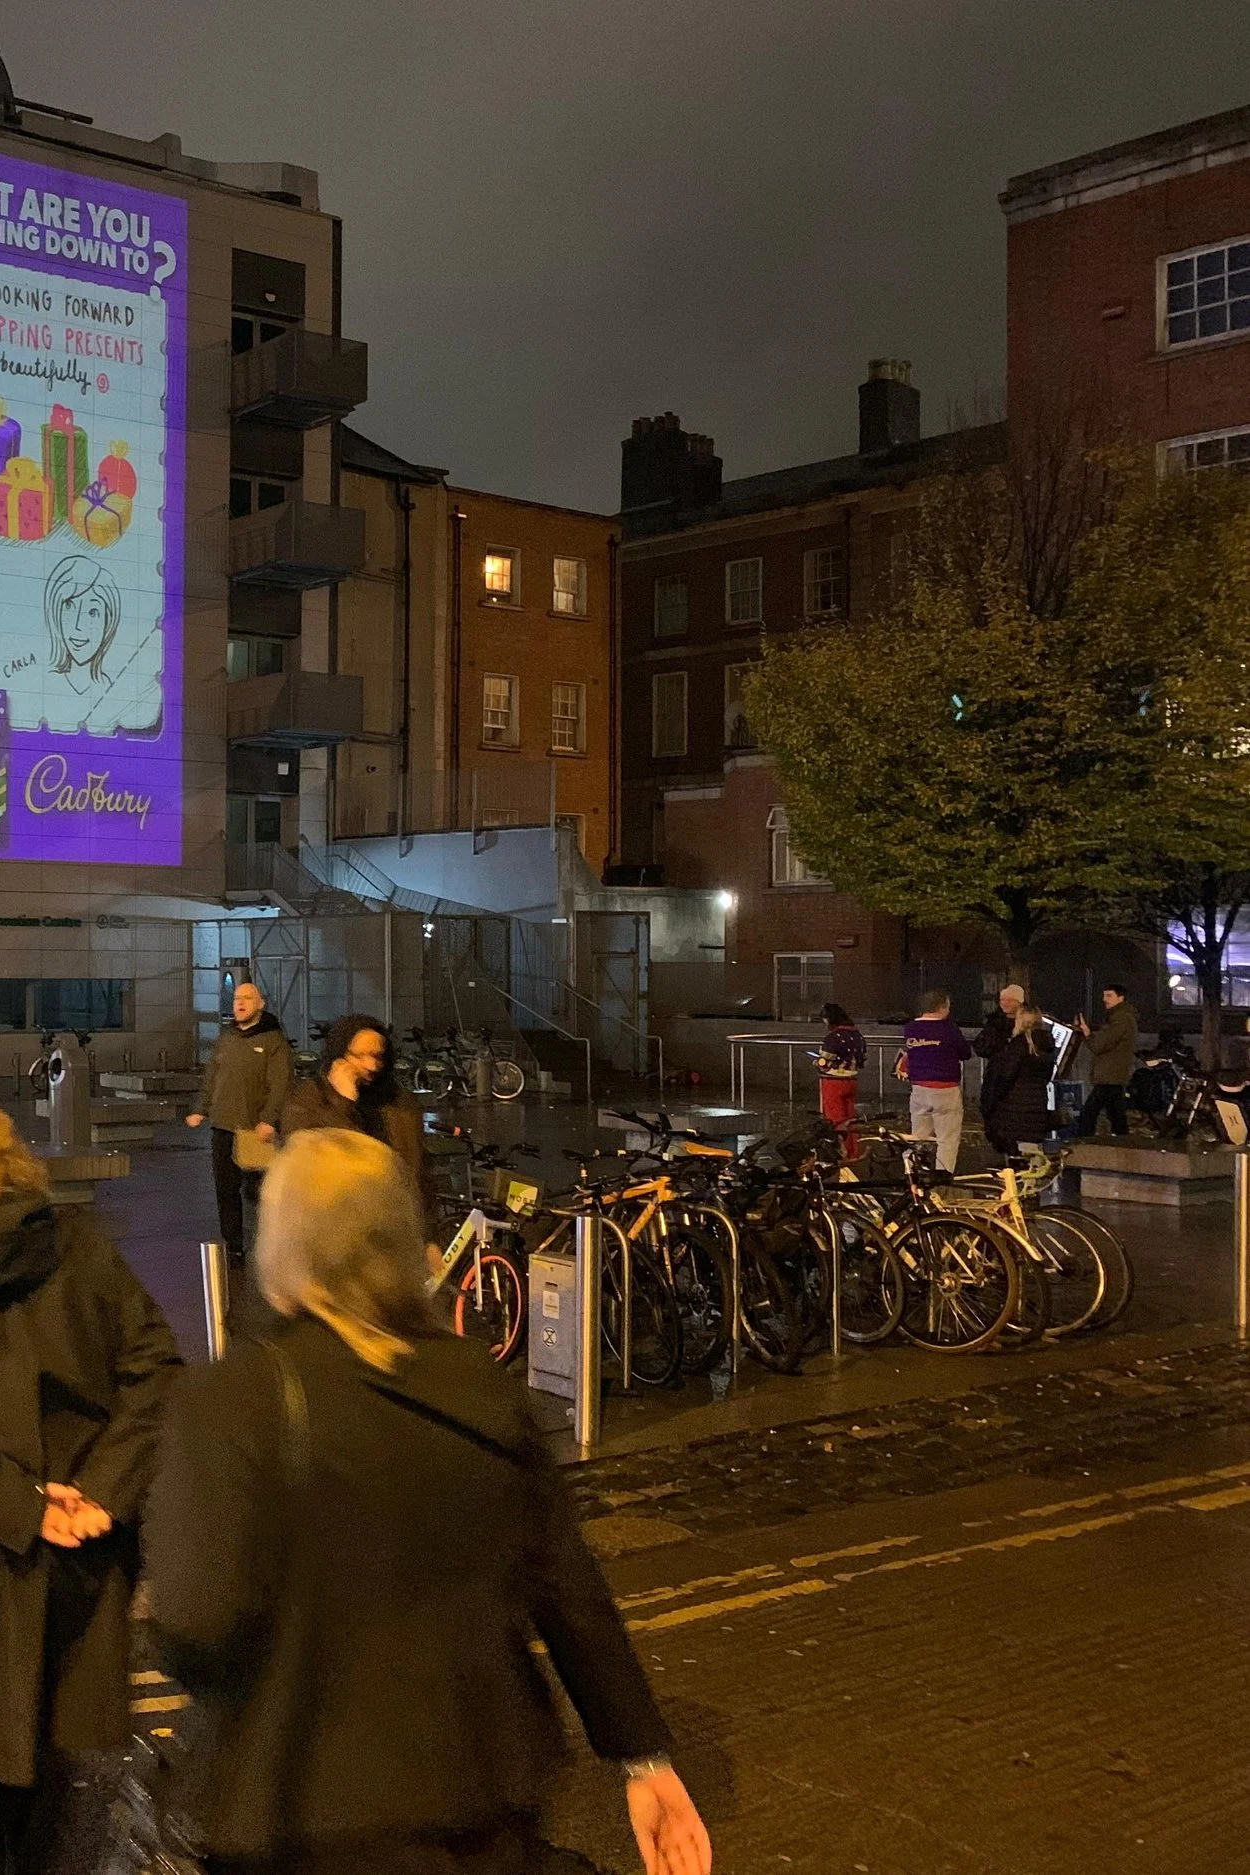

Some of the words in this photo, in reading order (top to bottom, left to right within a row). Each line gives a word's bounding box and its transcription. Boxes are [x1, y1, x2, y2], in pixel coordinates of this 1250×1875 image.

[19, 188, 81, 234] ARE
[86, 202, 151, 248] YOU
[45, 229, 117, 268] DOWN
[65, 294, 135, 327] FORWARD
[65, 327, 144, 366] PRESENTS
[3, 653, 37, 679] CARLA
[24, 754, 152, 830] Cadbury
